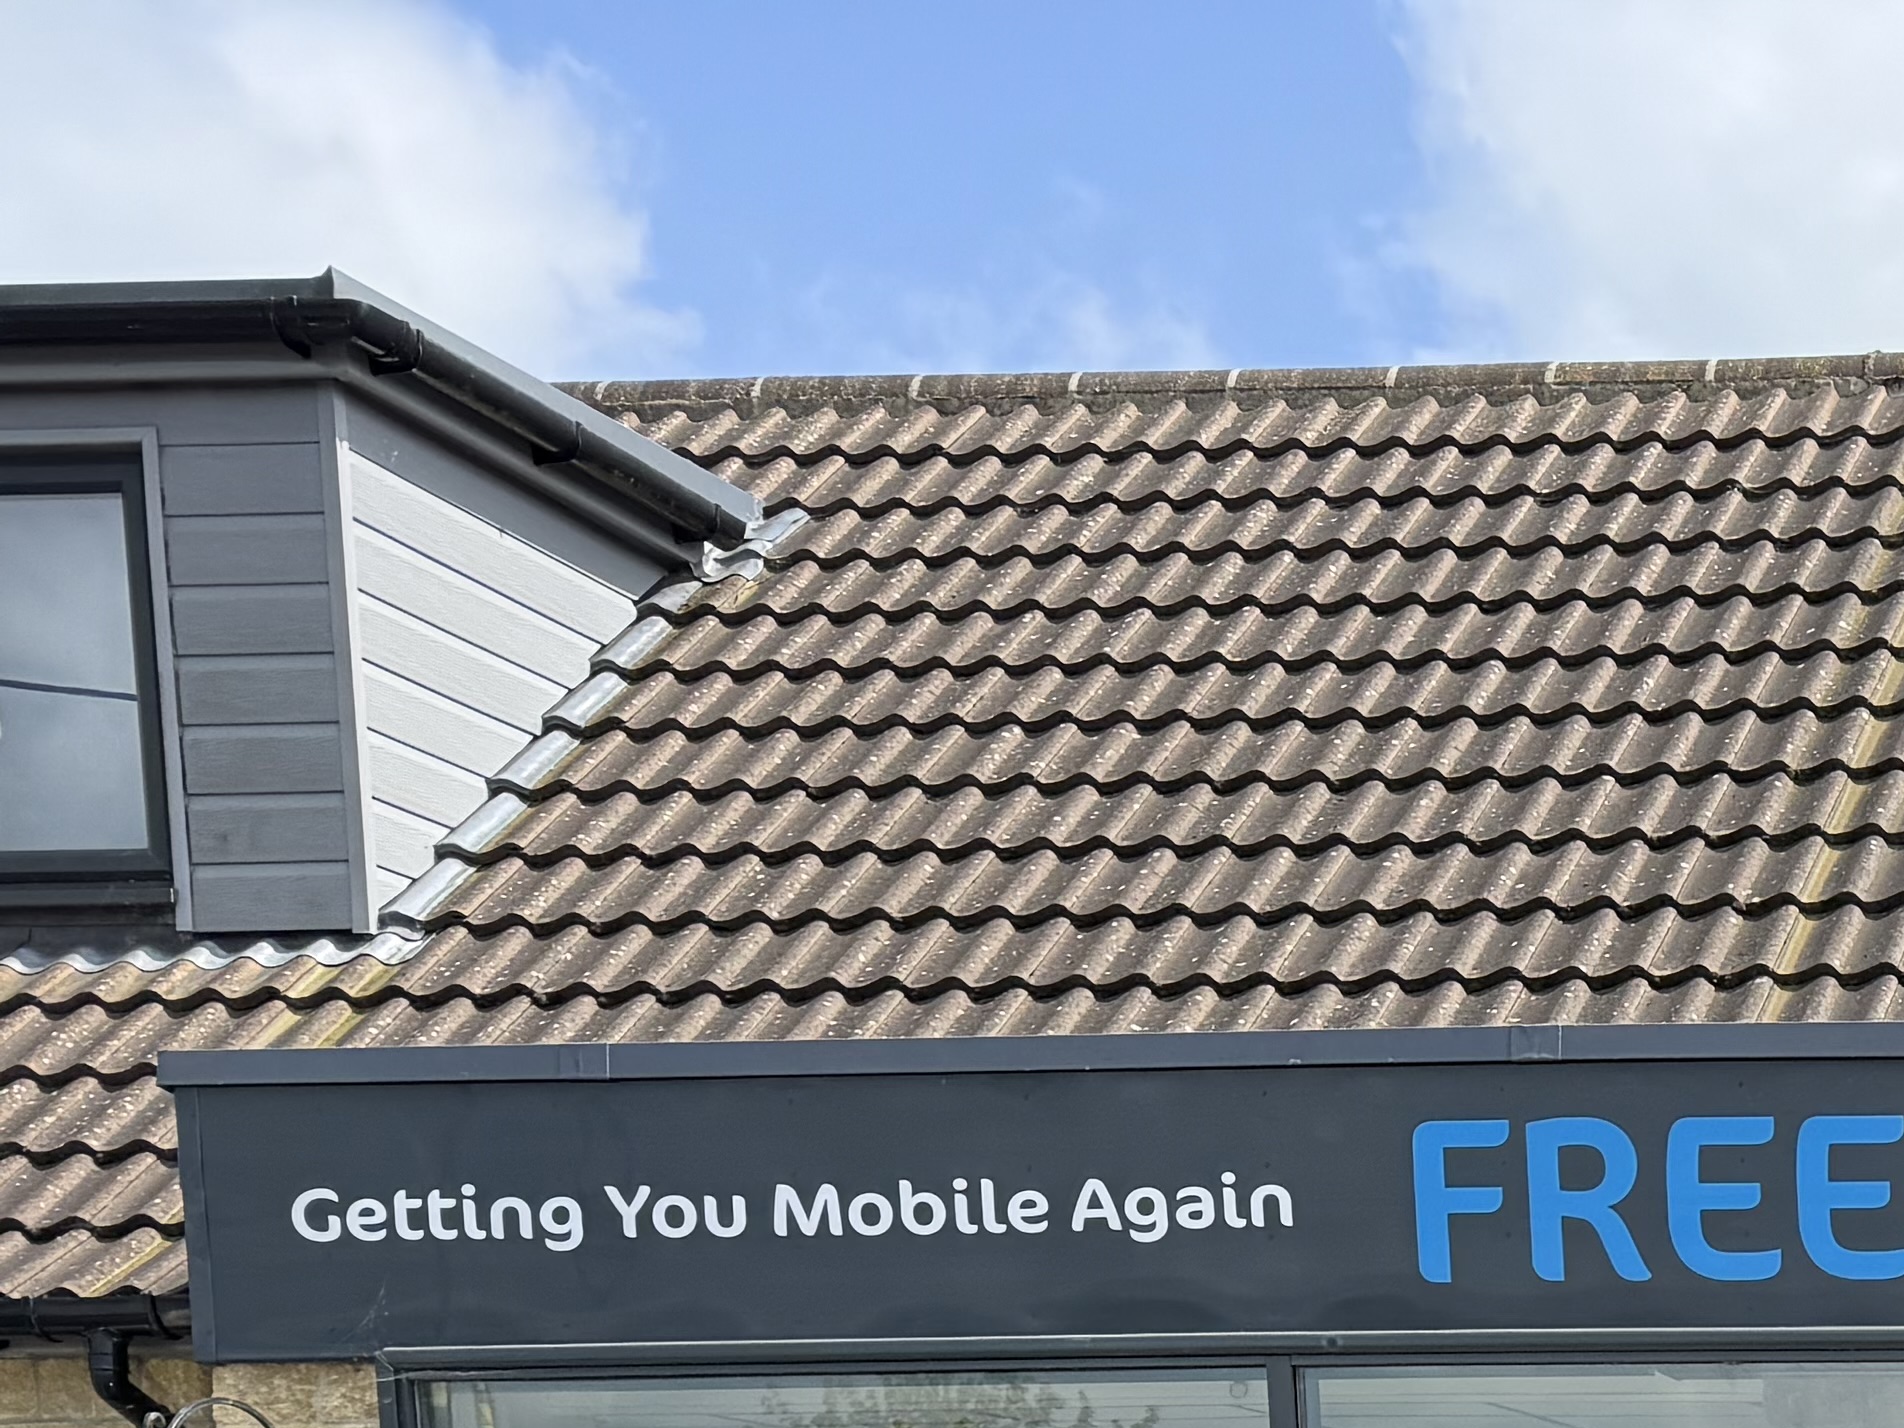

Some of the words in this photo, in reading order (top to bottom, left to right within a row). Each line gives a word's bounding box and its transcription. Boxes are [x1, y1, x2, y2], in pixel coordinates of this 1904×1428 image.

[290, 1184, 585, 1253] Getting
[602, 1184, 748, 1240] You
[772, 1177, 1050, 1238] Mobile
[1070, 1171, 1295, 1244] Again
